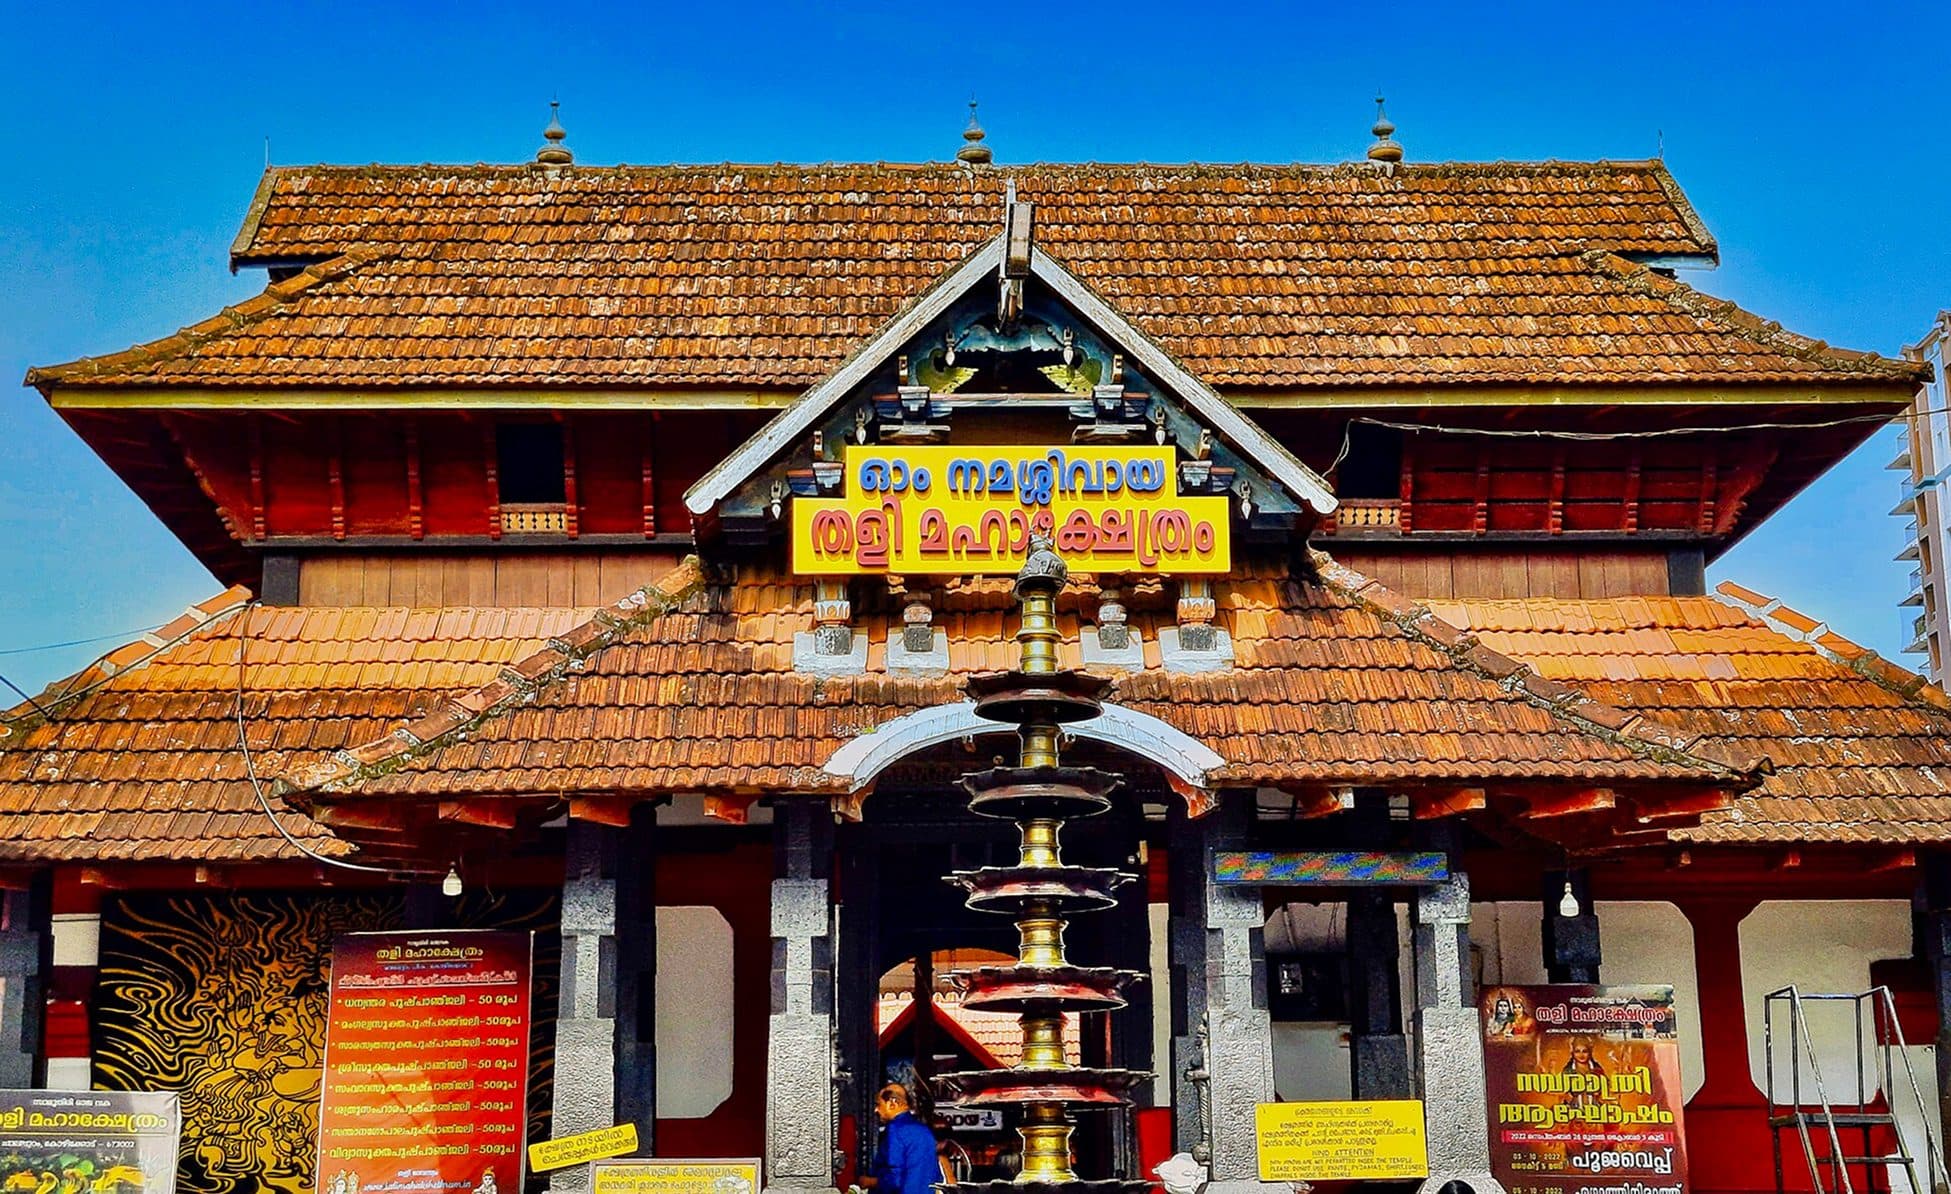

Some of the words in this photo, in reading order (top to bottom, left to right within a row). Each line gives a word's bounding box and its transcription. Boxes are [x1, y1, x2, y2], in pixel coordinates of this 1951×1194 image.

[860, 459, 930, 491] ഓം
[947, 450, 1165, 505] നമശ്ശിവായ
[811, 495, 902, 567] തളി
[919, 507, 1215, 566] മഹാക്ഷേത്രം
[376, 946, 401, 959] തളി
[405, 946, 483, 960] മഹാക്ഷേത്രം
[478, 995, 492, 1004] 50
[495, 995, 517, 1006] രൂപ
[1536, 1003, 1568, 1025] തളി
[1571, 1006, 1666, 1025] മഹാക്ഷേത്രം
[495, 1059, 517, 1070] രൂപ
[1517, 1066, 1651, 1100] നവരാത്രി
[0, 1106, 25, 1129] ളി
[29, 1112, 168, 1133] മഹാക്ഷേത്രം
[1499, 1103, 1673, 1129] ആഘോഷം
[1573, 1148, 1673, 1174] പൂജവെപ്പ്
